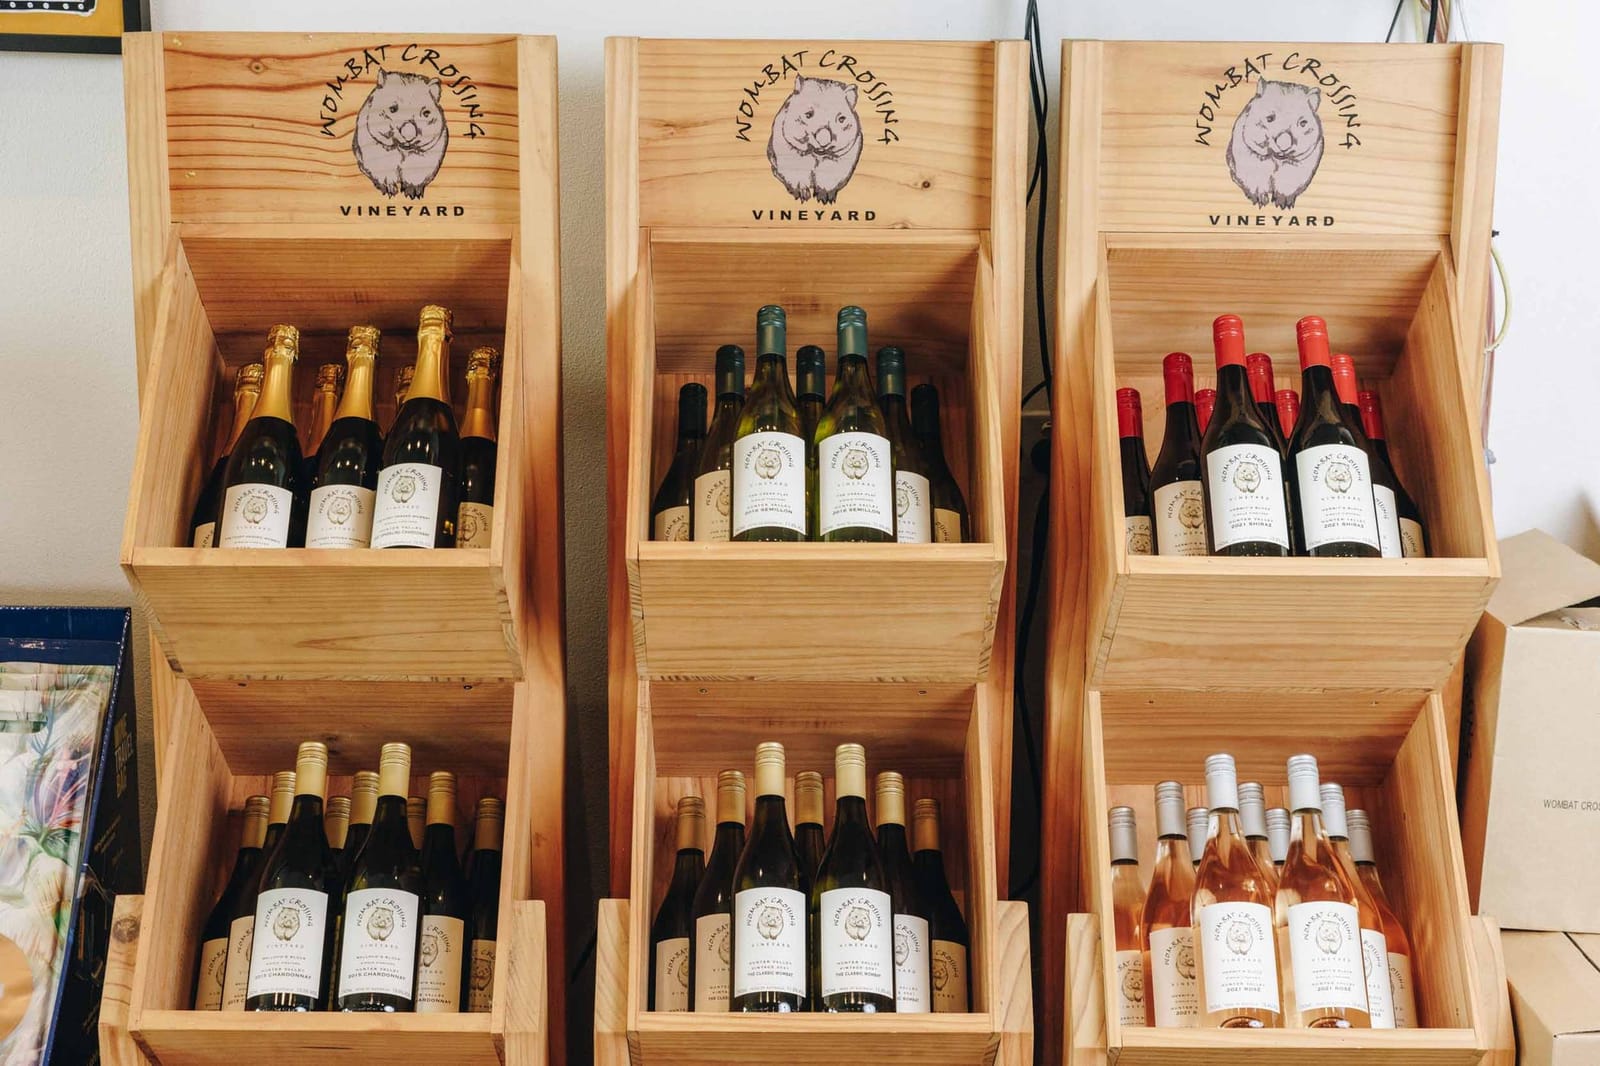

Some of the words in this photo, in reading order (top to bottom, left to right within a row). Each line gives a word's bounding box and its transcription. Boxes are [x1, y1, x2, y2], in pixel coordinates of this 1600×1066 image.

[320, 44, 391, 137] WOMBAT
[401, 43, 485, 139] CROSSING
[736, 50, 808, 142] WOMBAT
[819, 50, 899, 145] CROSSING
[1195, 53, 1272, 146] WOMBAT
[1282, 52, 1361, 149] CROSSING
[340, 205, 465, 217] VINEYARD
[752, 210, 877, 221] VINEYARD
[1209, 215, 1335, 226] VINEYARD
[1543, 799, 1579, 810] WOMBAT
